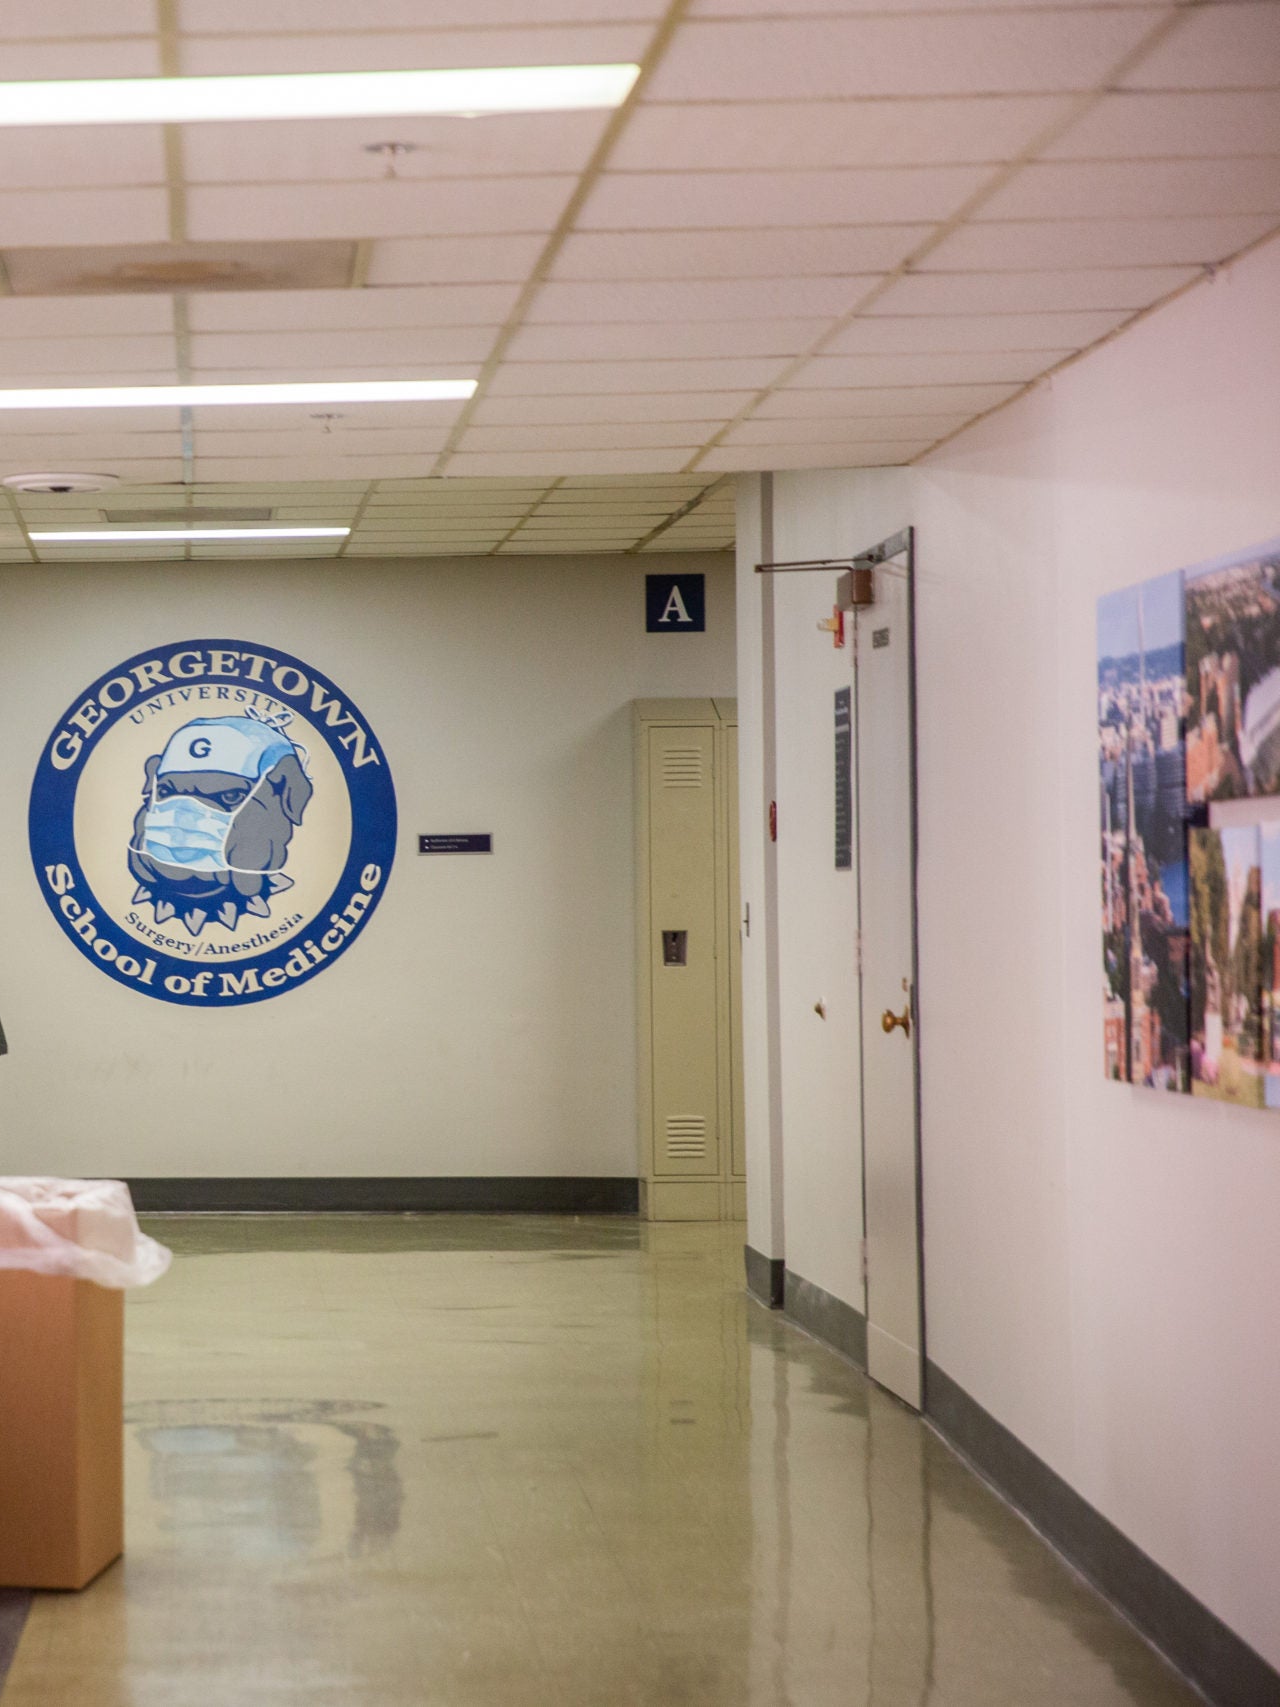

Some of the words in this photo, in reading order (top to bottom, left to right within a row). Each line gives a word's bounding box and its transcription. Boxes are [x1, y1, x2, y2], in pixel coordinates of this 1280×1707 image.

[657, 584, 693, 622] A
[49, 649, 381, 771] GEORGETOWN
[189, 737, 212, 758] G
[44, 863, 157, 985] School
[163, 971, 214, 997] of
[218, 863, 382, 997] Medicine
[124, 911, 304, 957] Surgery/Anesthesia
